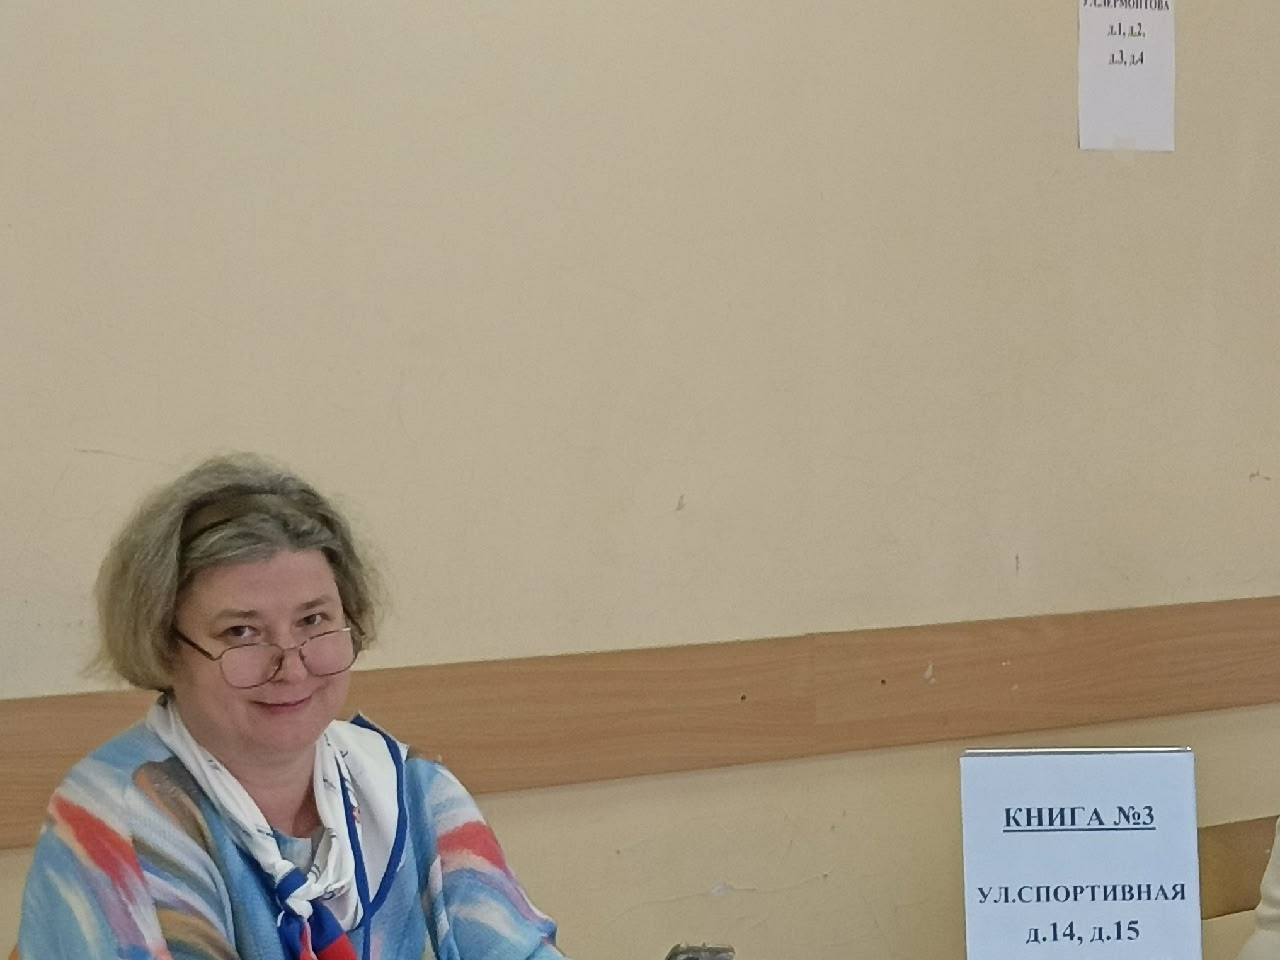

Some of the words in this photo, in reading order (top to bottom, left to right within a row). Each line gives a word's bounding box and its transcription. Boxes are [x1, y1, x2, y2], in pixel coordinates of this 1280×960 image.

[1107, 22, 1126, 38] д.1,
[1108, 49, 1127, 66] д.3,
[1129, 51, 1144, 66] д.4
[1003, 806, 1105, 828] КНИГА
[1113, 805, 1156, 827] №3
[977, 883, 1187, 904] УЛ.СПОРТИВНАЯ
[1025, 920, 1084, 946] д.14,
[1090, 920, 1141, 944] д.15
